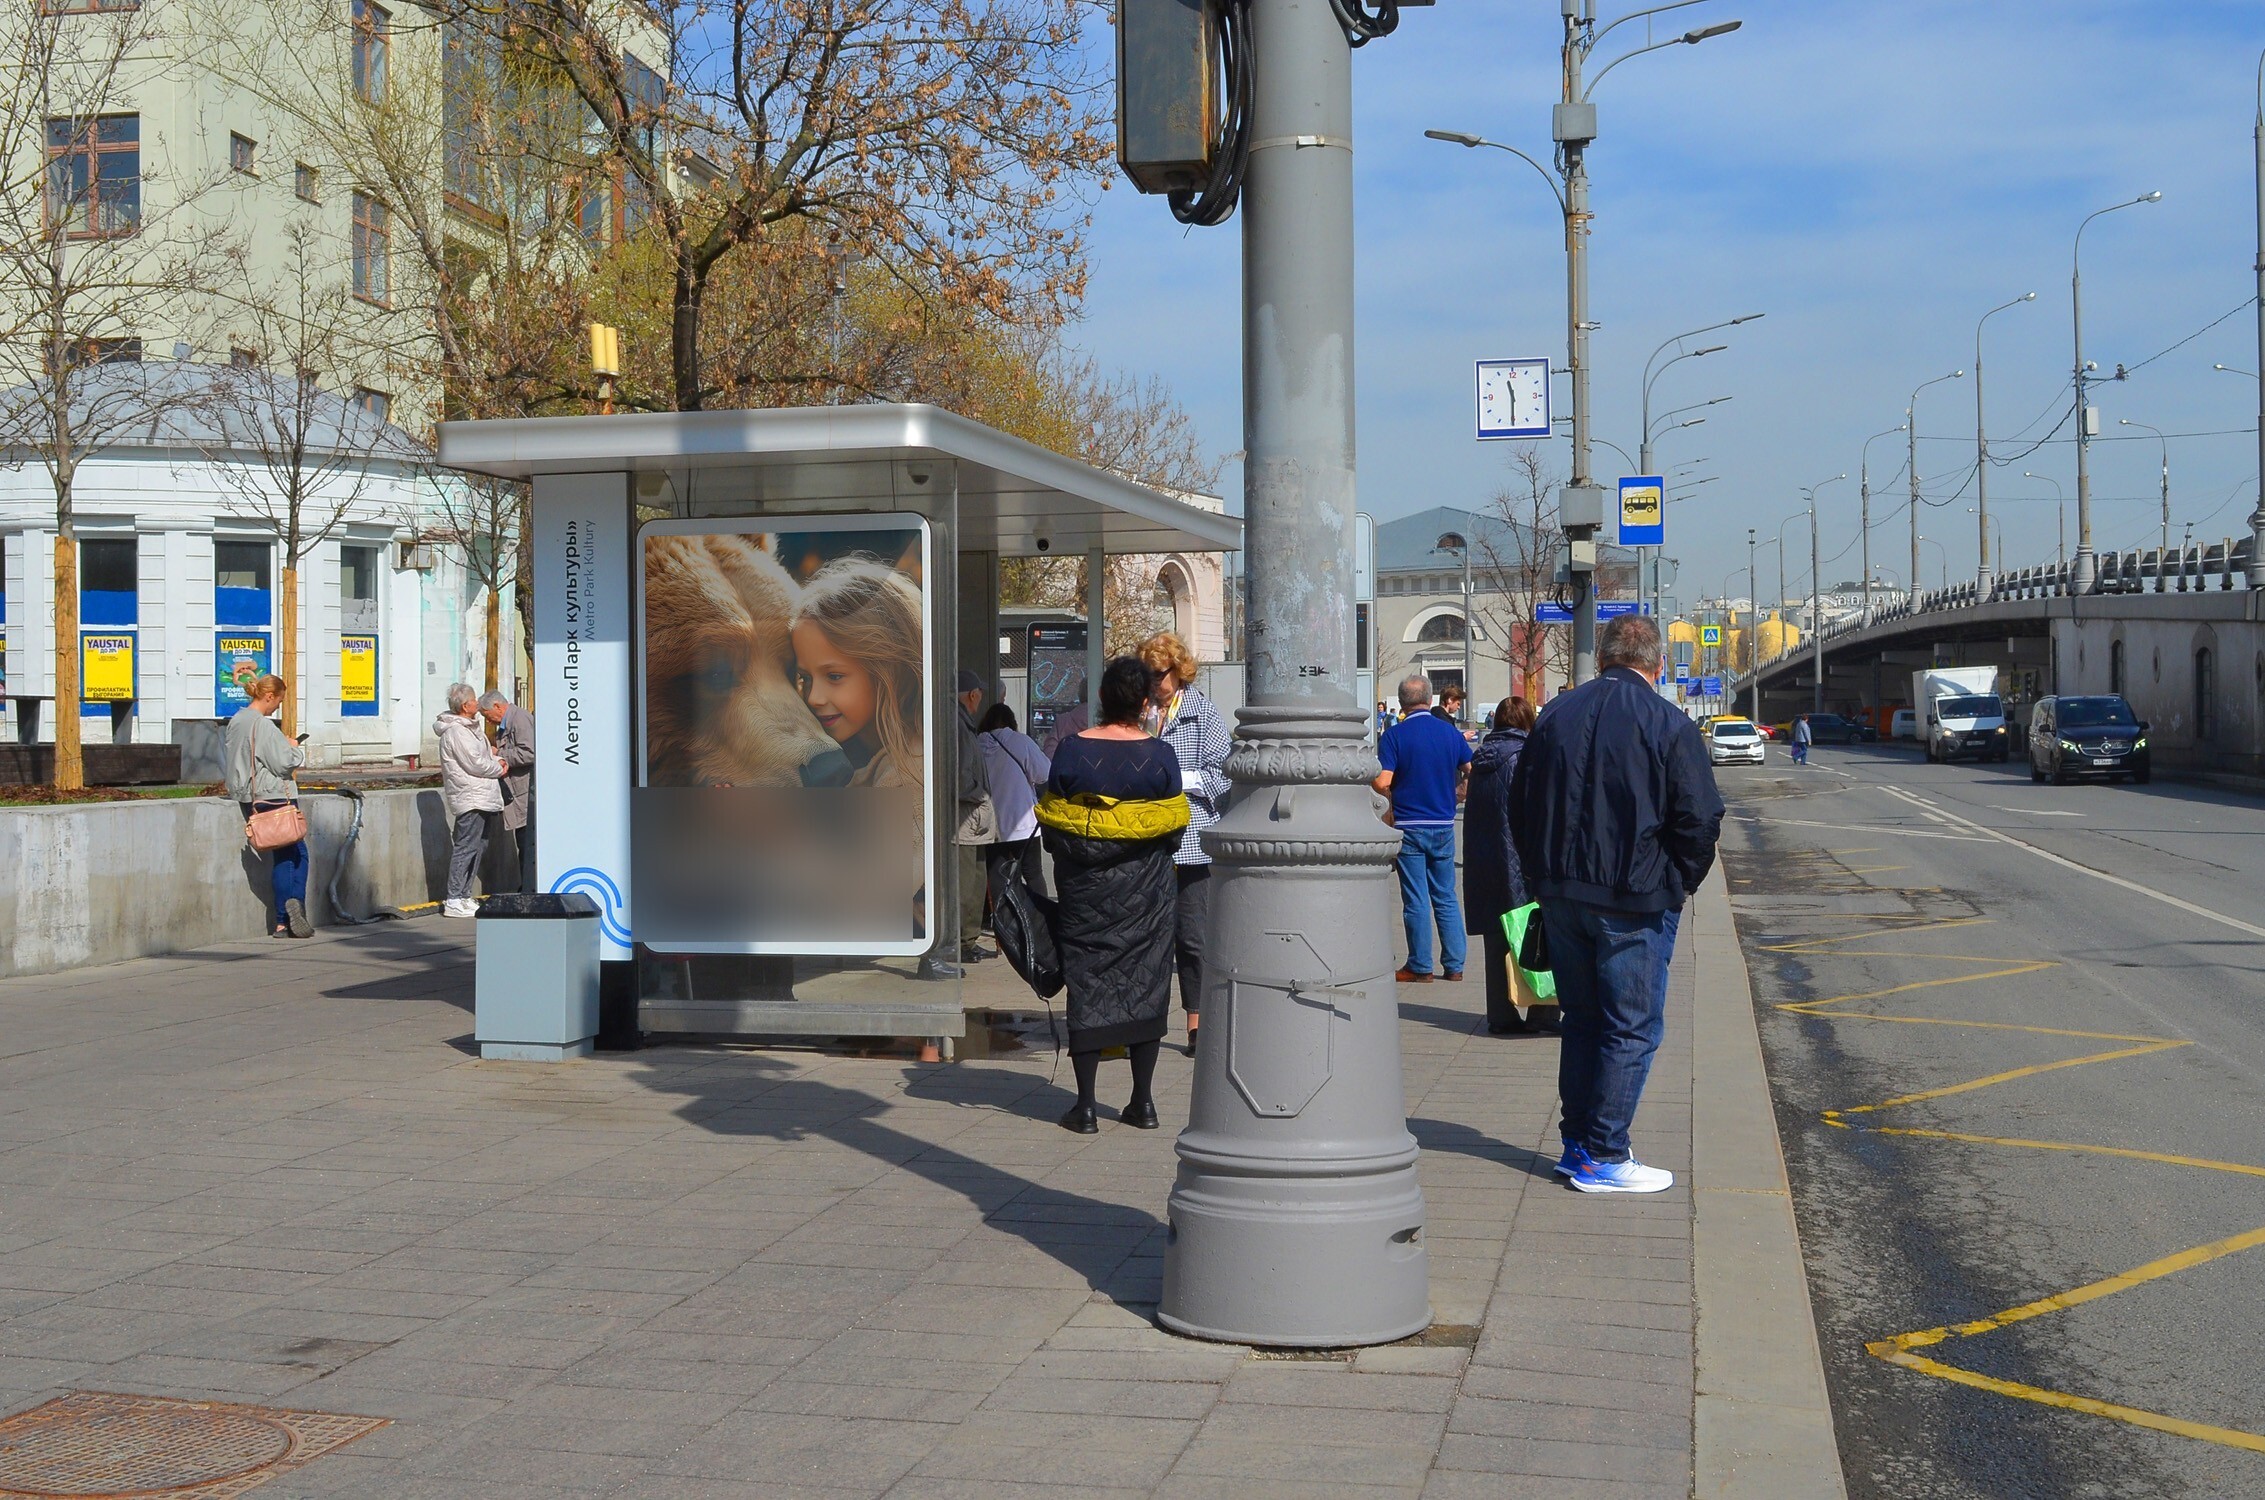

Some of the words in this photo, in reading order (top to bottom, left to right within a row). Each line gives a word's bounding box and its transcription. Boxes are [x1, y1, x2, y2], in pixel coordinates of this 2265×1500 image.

[584, 520, 596, 564] Kultury
[566, 520, 580, 622] культуры»
[584, 569, 594, 596] Park
[585, 601, 594, 640] Metro
[87, 639, 130, 648] YAUSTAL
[222, 641, 264, 649] YAUSTAL
[341, 640, 372, 649] YAUSTAL
[564, 630, 581, 690] «Парк
[564, 698, 582, 765] Метро
